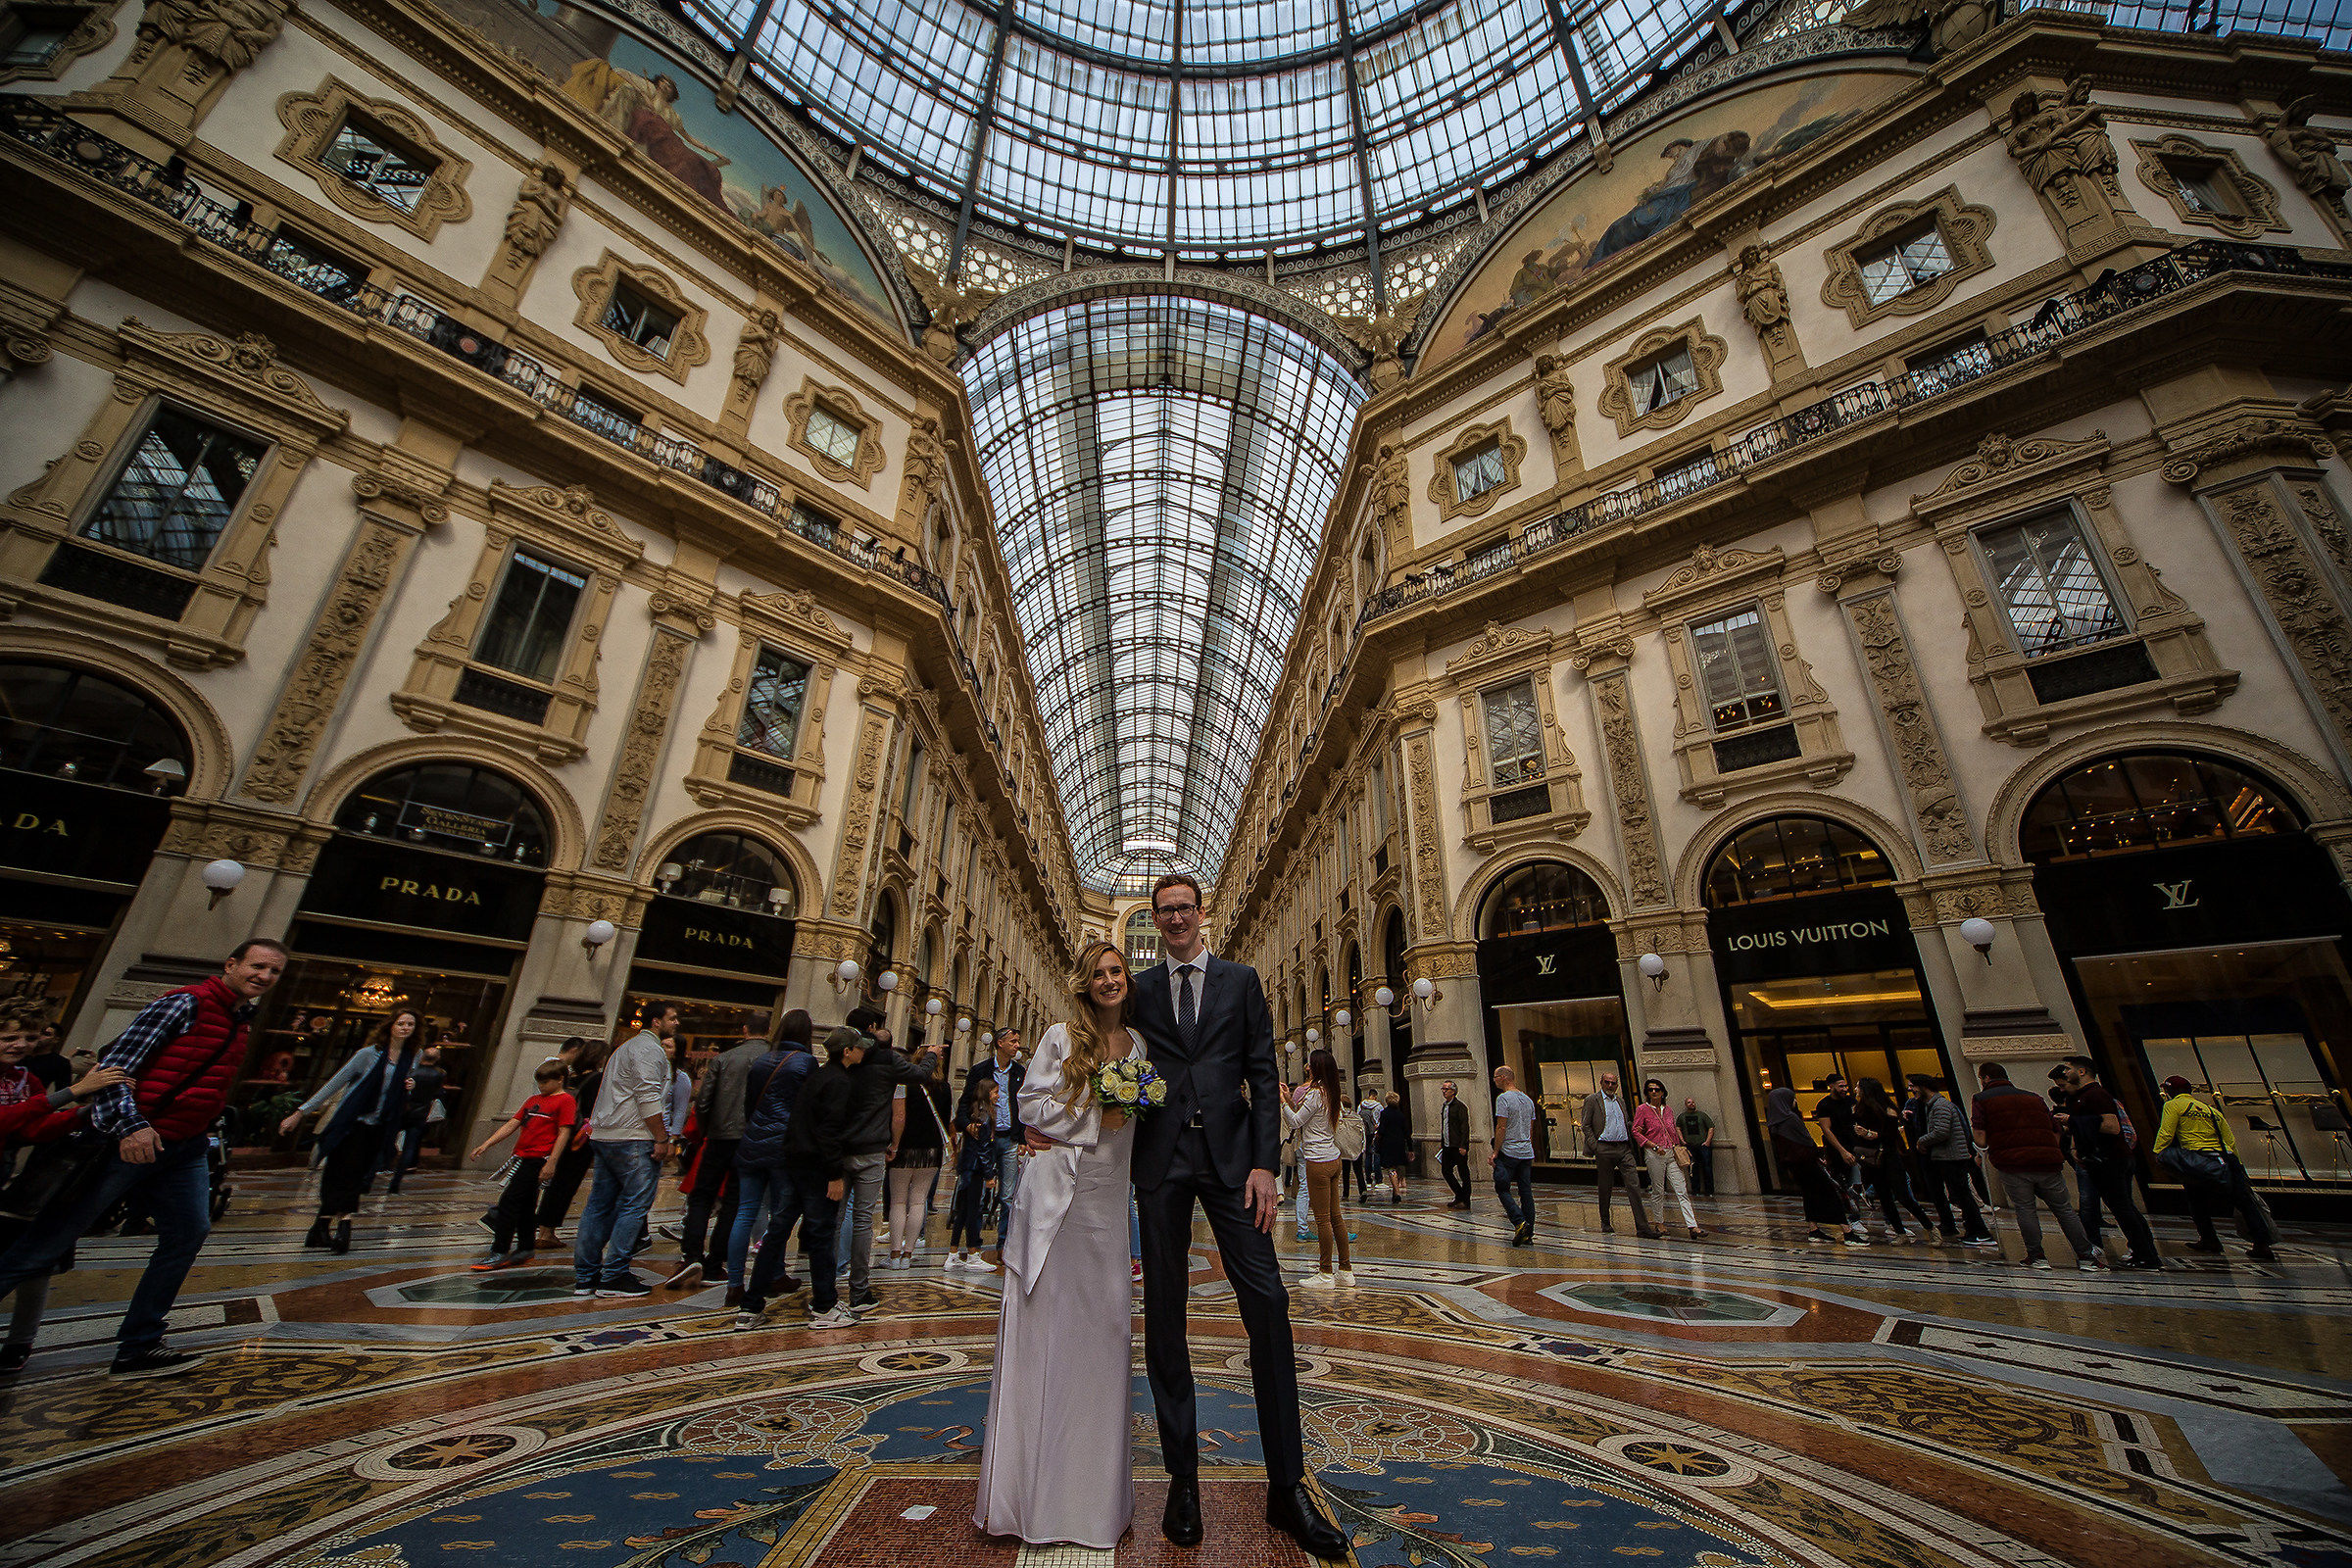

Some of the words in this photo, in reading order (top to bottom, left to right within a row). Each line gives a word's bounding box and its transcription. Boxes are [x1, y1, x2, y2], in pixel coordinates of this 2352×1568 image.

[0, 812, 71, 837] DA
[379, 876, 481, 906] PRADA
[2153, 879, 2199, 910] LV
[684, 927, 753, 949] PRADA
[1728, 931, 1788, 952] LOUIS
[1790, 919, 1889, 945] VUITTON
[1536, 954, 1557, 975] LV
[308, 1417, 447, 1456] FERT
[1684, 1424, 1803, 1461] FERT
